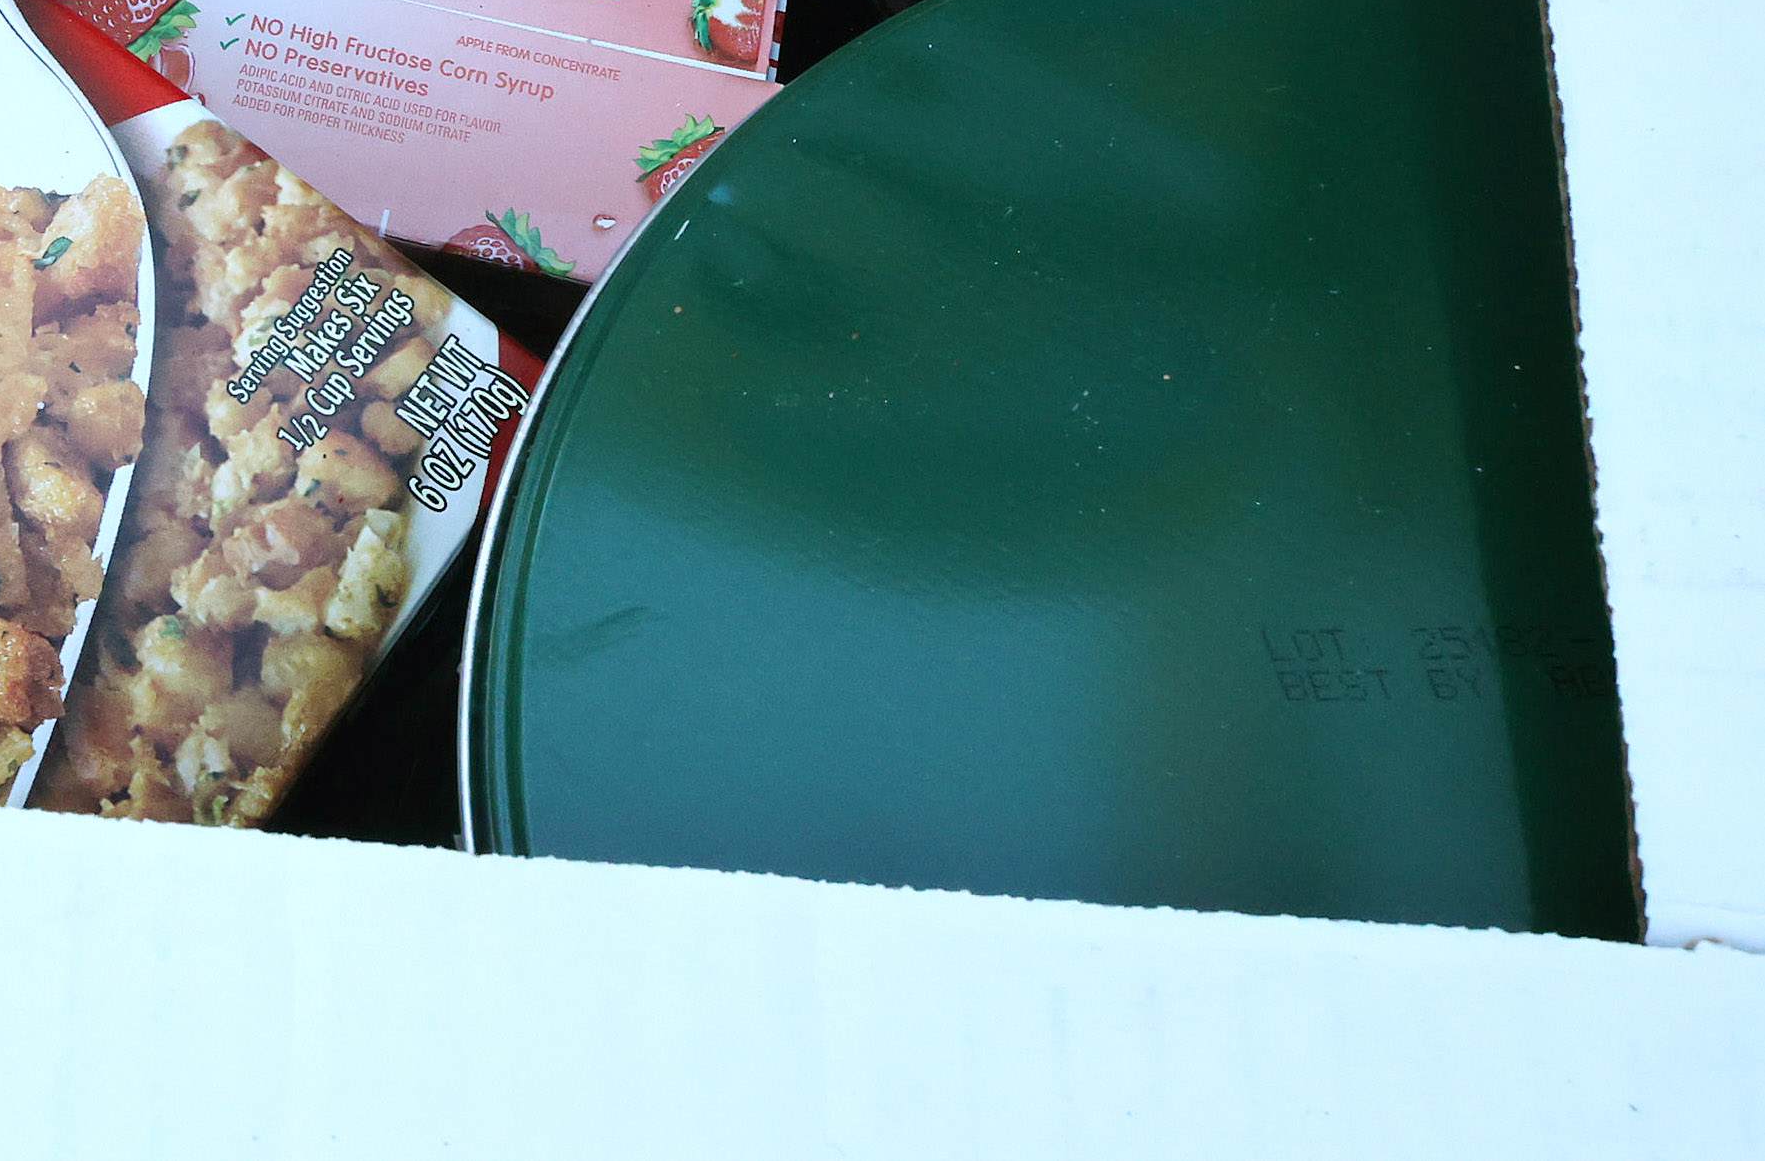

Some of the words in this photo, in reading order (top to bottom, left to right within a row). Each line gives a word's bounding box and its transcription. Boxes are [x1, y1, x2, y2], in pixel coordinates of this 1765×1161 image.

[244, 37, 280, 61] NO
[284, 47, 430, 97] Preservatives
[250, 13, 284, 37] NO
[289, 21, 339, 52] High
[344, 37, 433, 74] Fructose
[439, 58, 488, 86] Corn
[494, 73, 556, 103] Syrup
[456, 34, 493, 56] APPLE
[495, 44, 531, 61] FROM
[533, 50, 622, 82] CONCENTRATE
[232, 94, 271, 116] ADDED
[273, 102, 296, 119] FOR
[297, 107, 341, 129] PROPER
[342, 117, 406, 145] THICKNESS
[236, 79, 302, 104] POTASSIUM
[304, 93, 349, 116] CITRATE
[350, 104, 376, 122] AND
[378, 110, 424, 132] SODIUM
[425, 121, 471, 144] CITRATE
[239, 63, 278, 83] ADIPIC
[279, 71, 308, 90] ACID
[309, 79, 334, 96] AND
[336, 83, 371, 104] CITRIC
[372, 93, 402, 111] ACID
[403, 99, 433, 118] USED
[436, 107, 457, 123] FOR
[227, 337, 291, 405] Serving
[274, 247, 355, 343] Suggestion
[284, 309, 356, 384] Makes
[334, 273, 382, 316] Six
[277, 412, 329, 451] 1/2
[305, 371, 356, 417] Cup
[335, 288, 415, 379] Servings
[395, 371, 458, 439] NET
[429, 333, 485, 390] WT
[443, 363, 531, 461] (170g)
[408, 476, 448, 513] 6
[420, 437, 476, 492] OZ
[1274, 668, 1393, 701] BEST
